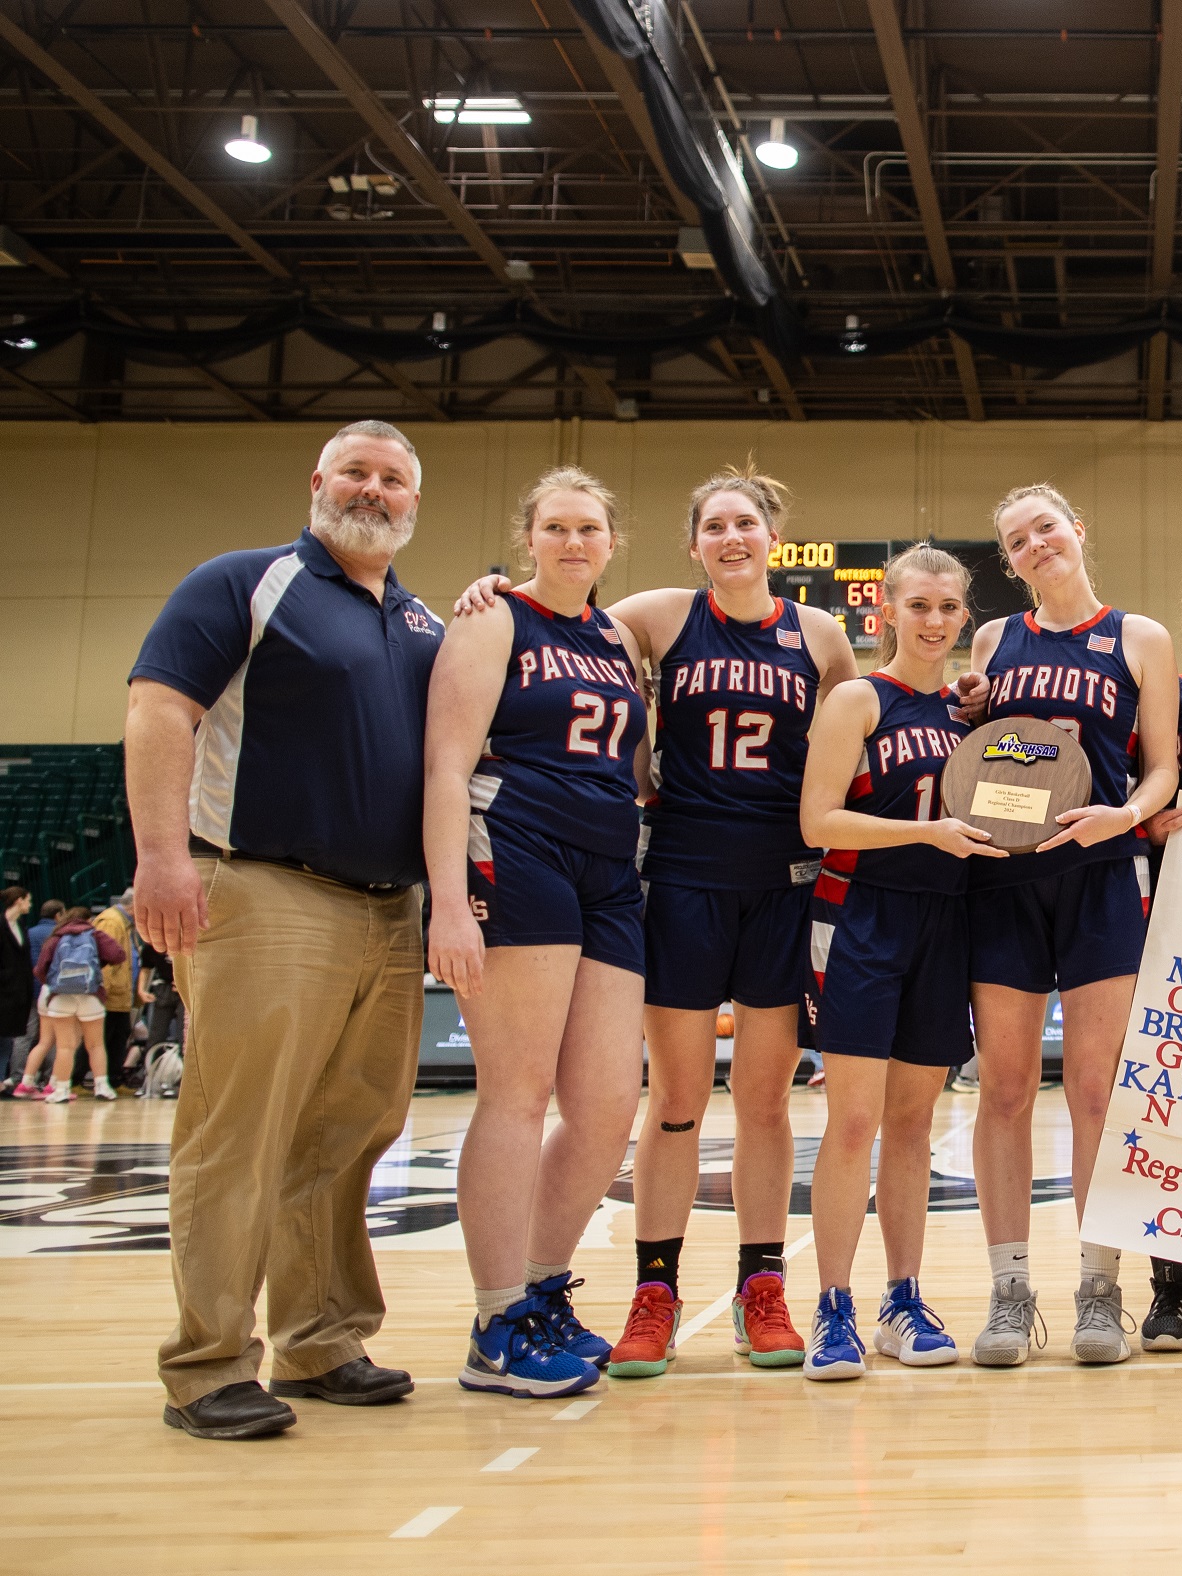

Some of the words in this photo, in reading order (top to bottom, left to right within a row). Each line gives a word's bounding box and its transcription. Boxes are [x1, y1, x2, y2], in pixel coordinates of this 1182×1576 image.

[767, 542, 835, 568] 20:00
[834, 568, 885, 581] PATRIOTS
[847, 582, 879, 607] 69
[404, 610, 429, 627] CVS
[864, 615, 878, 635] 0
[518, 644, 640, 695] PATRIOT
[672, 657, 807, 712] PATRIOTS
[987, 665, 1118, 720] PATRIOTS
[566, 690, 629, 761] 21
[706, 707, 776, 771] 12
[997, 741, 1058, 757] NYSPHSAA
[914, 773, 944, 822] 1
